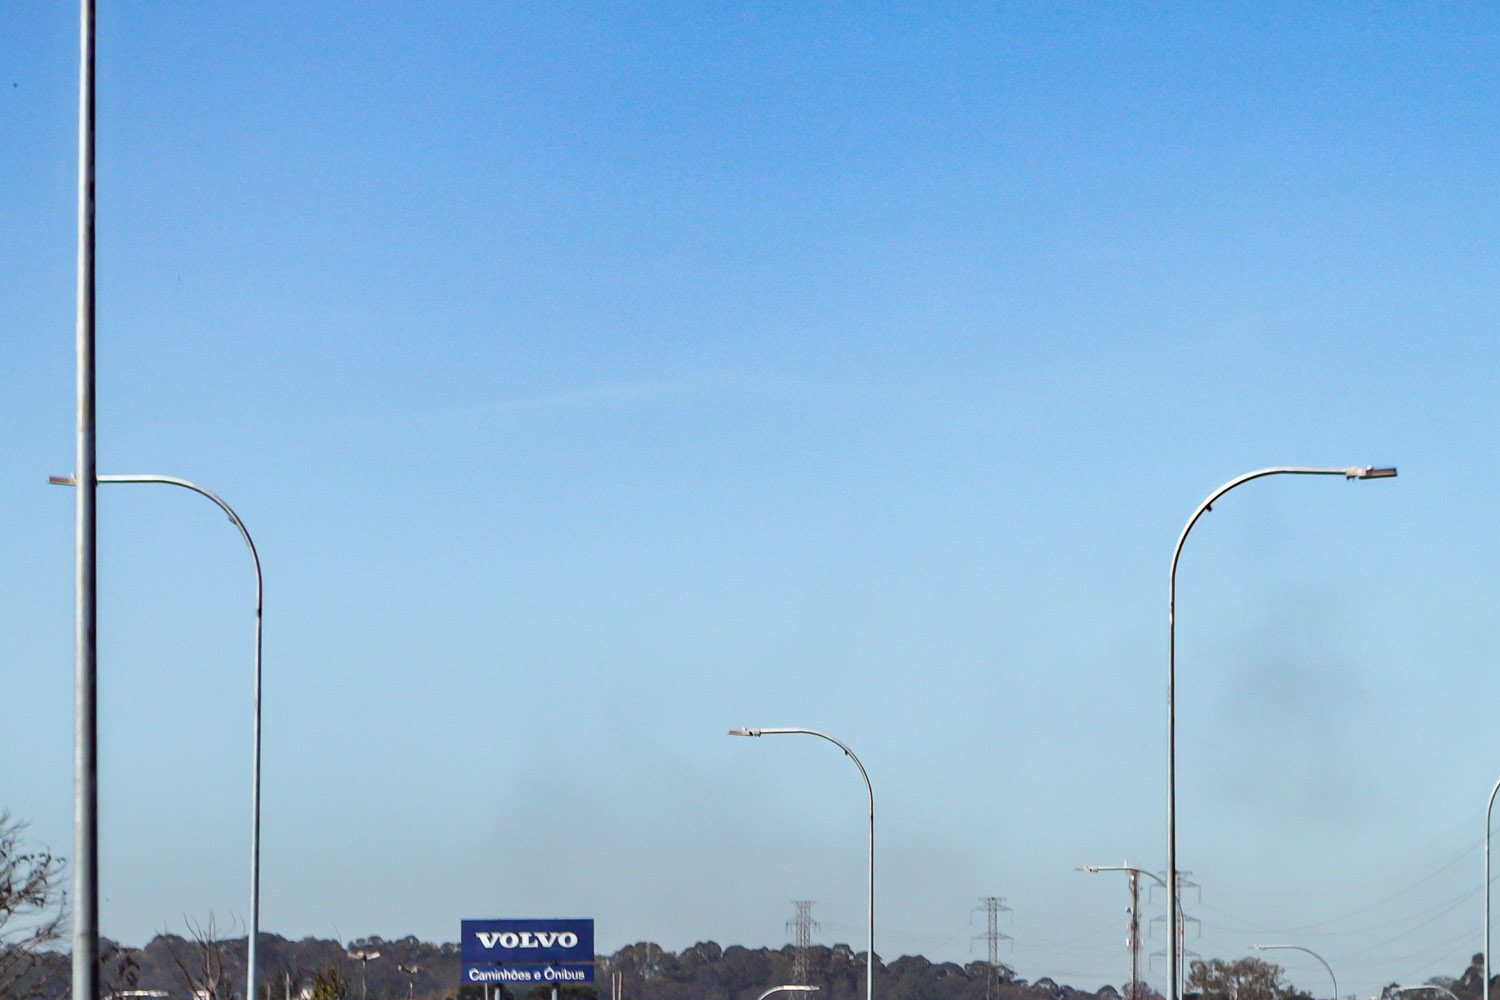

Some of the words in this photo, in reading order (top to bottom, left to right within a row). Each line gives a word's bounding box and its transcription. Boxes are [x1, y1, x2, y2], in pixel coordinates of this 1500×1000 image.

[475, 931, 578, 949] VOLVO
[468, 967, 531, 981] Caminhões
[534, 971, 542, 980] e
[544, 966, 585, 980] Ônibus
